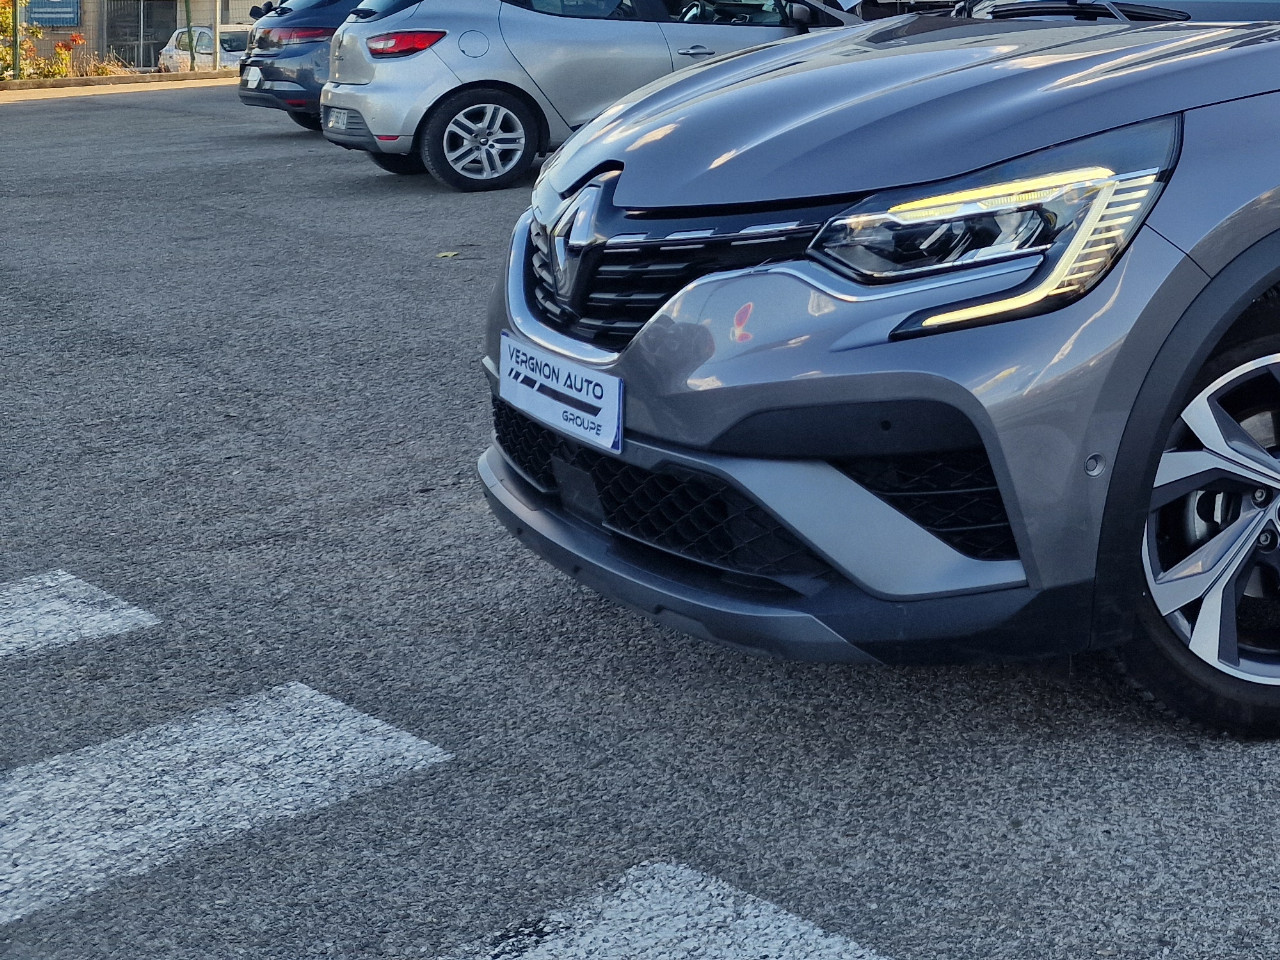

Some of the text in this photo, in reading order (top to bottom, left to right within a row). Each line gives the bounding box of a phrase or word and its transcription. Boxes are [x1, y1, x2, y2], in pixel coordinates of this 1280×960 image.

[508, 344, 604, 400] VERGNON AUTO
[561, 410, 603, 437] GROUPE
